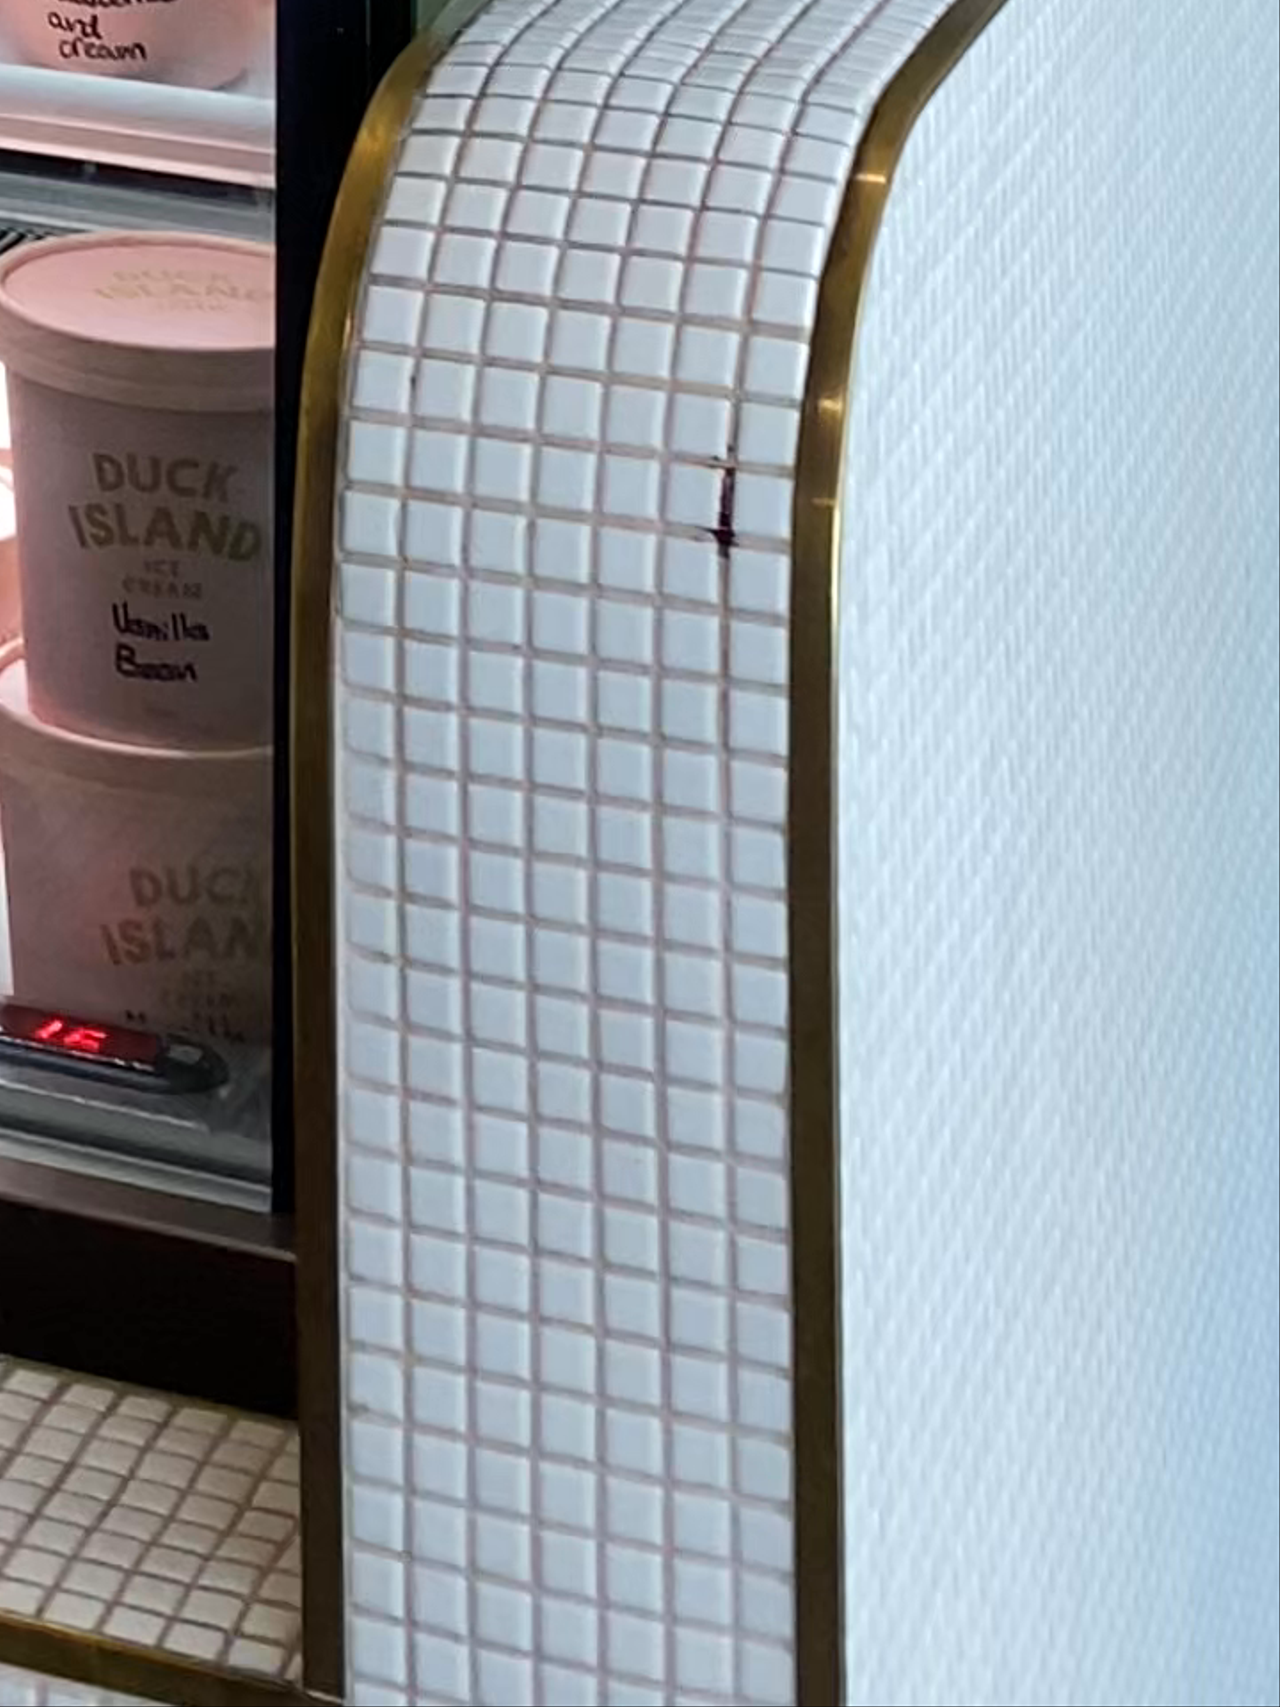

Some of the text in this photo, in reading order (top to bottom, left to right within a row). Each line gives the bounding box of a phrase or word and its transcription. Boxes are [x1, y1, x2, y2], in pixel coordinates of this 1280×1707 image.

[47, 10, 102, 41] and
[57, 38, 148, 63] cream
[91, 451, 239, 505] DUCK
[67, 501, 264, 563] ISLAND
[114, 642, 199, 683] Bean
